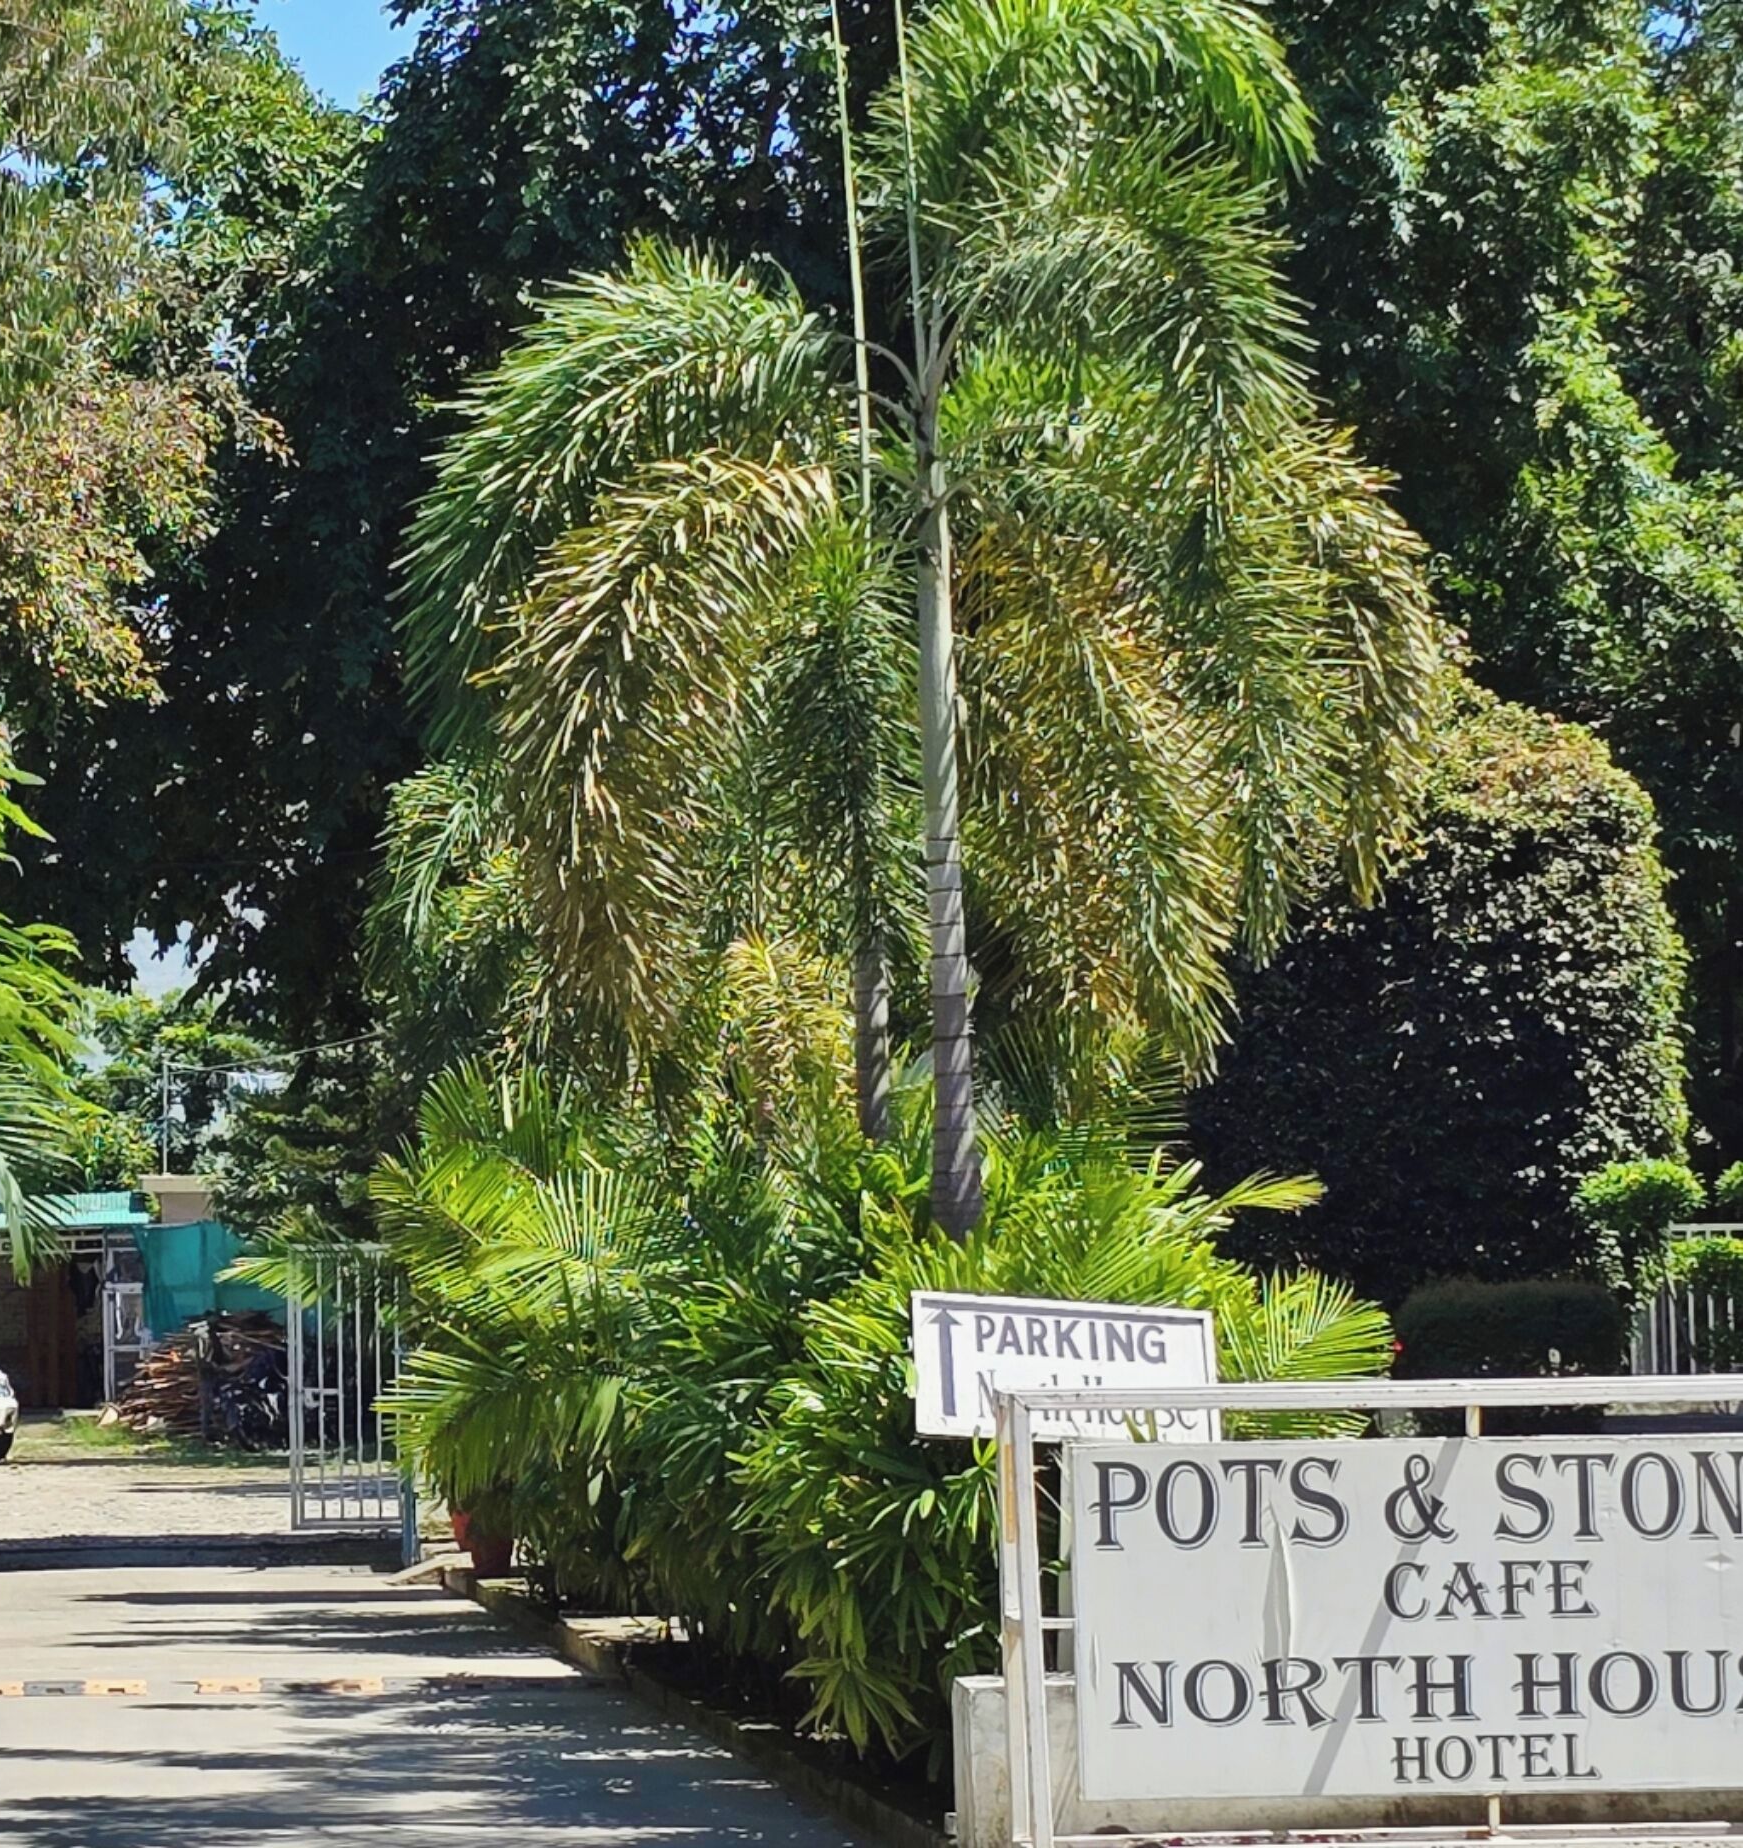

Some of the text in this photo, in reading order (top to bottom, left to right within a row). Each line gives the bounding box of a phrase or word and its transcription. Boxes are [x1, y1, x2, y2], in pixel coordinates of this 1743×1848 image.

[973, 1314, 1168, 1365] PARKING
[1088, 1451, 1743, 1551] POTS & STON
[1384, 1559, 1600, 1622] CAFE
[1110, 1650, 1743, 1732] NORTH HOU
[1390, 1732, 1602, 1783] HOTEL
